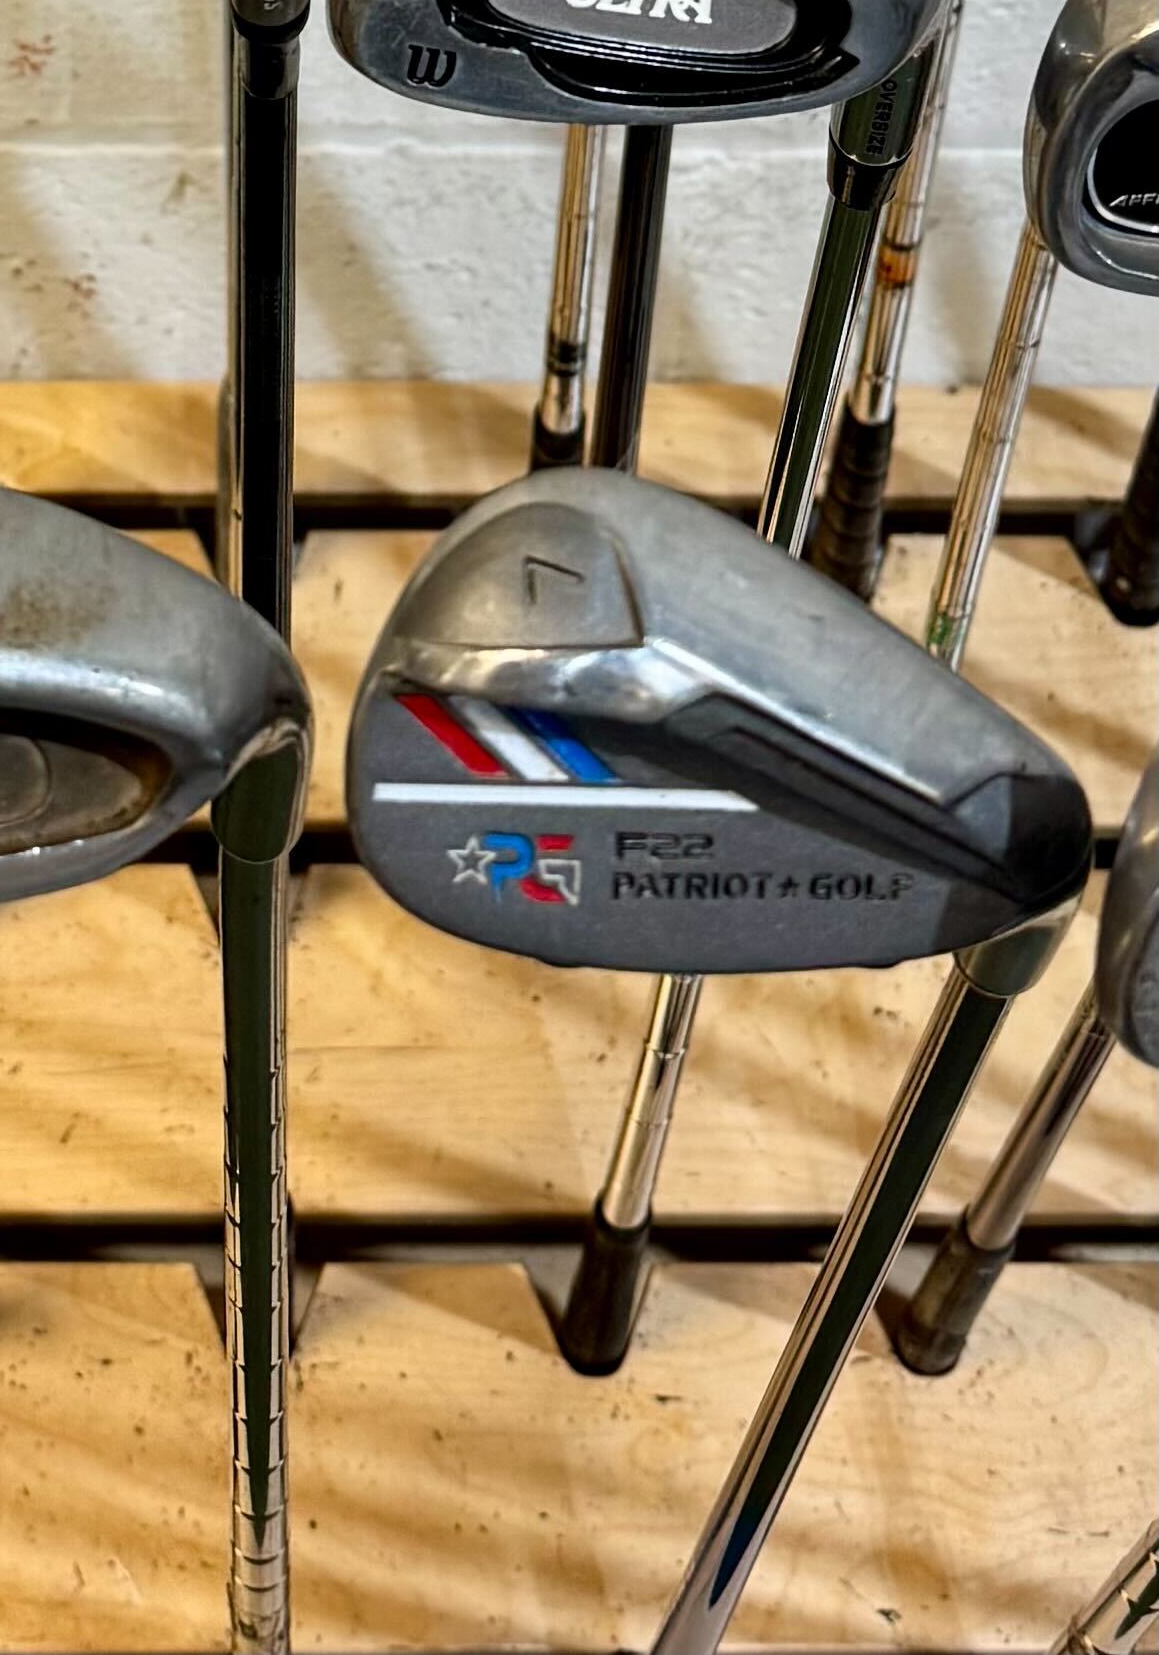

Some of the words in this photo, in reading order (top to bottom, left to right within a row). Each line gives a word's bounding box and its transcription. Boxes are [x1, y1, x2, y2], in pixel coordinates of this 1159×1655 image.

[866, 79, 898, 154] OVERSIZE
[613, 831, 715, 860] F22
[611, 871, 778, 901] PATRIOT
[809, 871, 915, 901] GOLF
